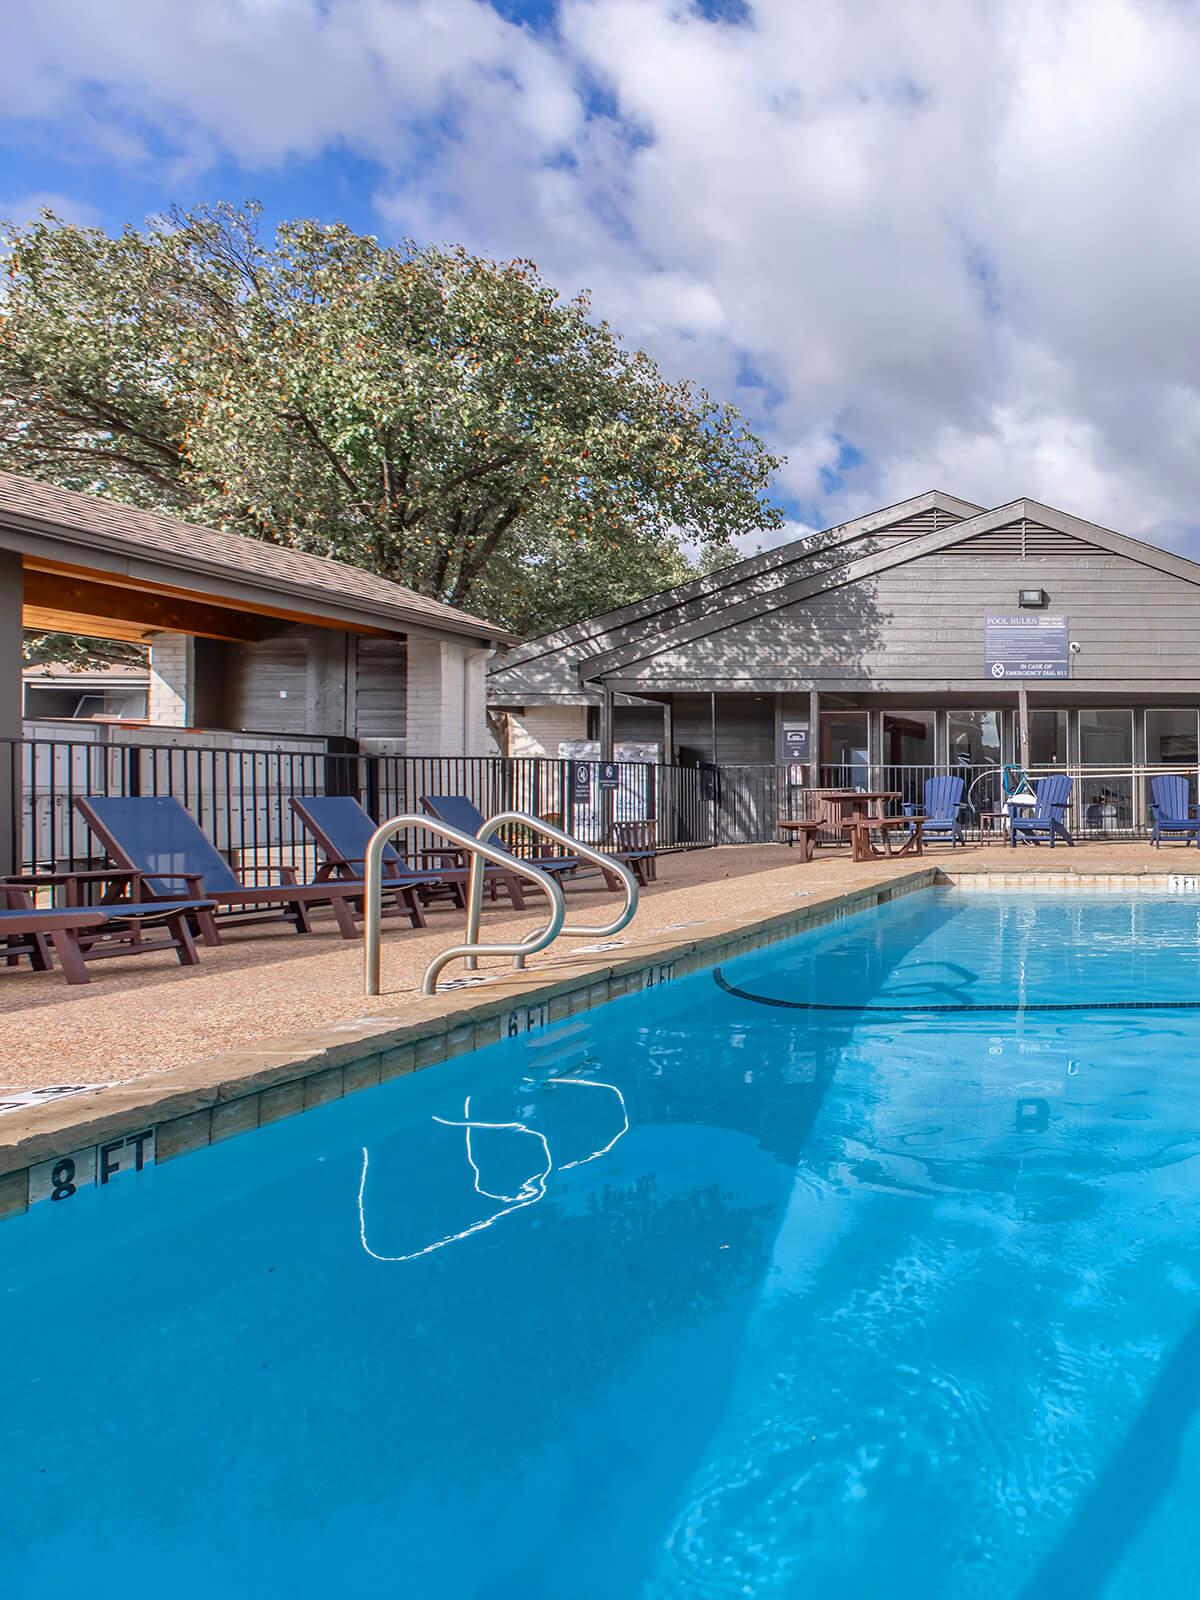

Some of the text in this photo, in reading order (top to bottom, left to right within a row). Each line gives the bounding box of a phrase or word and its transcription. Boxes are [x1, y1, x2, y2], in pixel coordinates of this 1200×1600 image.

[987, 616, 1009, 625] POOL
[1010, 616, 1038, 625] RULES
[646, 967, 653, 987] 4
[508, 1010, 518, 1038] 6
[51, 1130, 153, 1202] 8 FT
